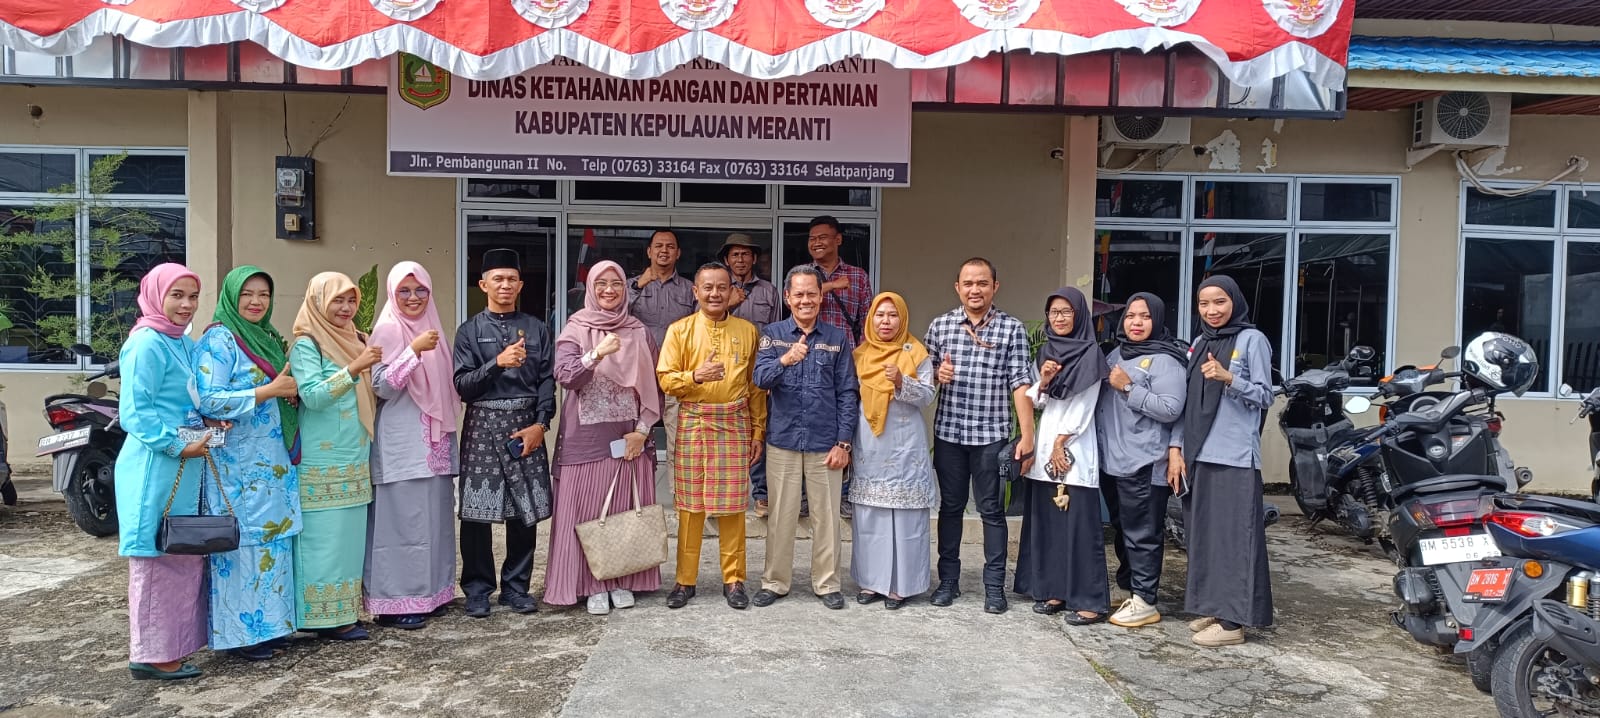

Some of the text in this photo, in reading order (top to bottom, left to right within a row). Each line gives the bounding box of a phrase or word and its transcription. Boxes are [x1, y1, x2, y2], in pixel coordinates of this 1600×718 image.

[468, 75, 878, 107] DINAS KETAHANAN PANGAN DAN PERTANIAN
[515, 111, 831, 141] KABUPATEN KEPULAUAN MERANTI
[409, 154, 895, 181] Jln. Pembangunan II No. Telp (0763) 33164 Fax (0763) 33164 Selatpanjang
[1441, 537, 1474, 550] 5538
